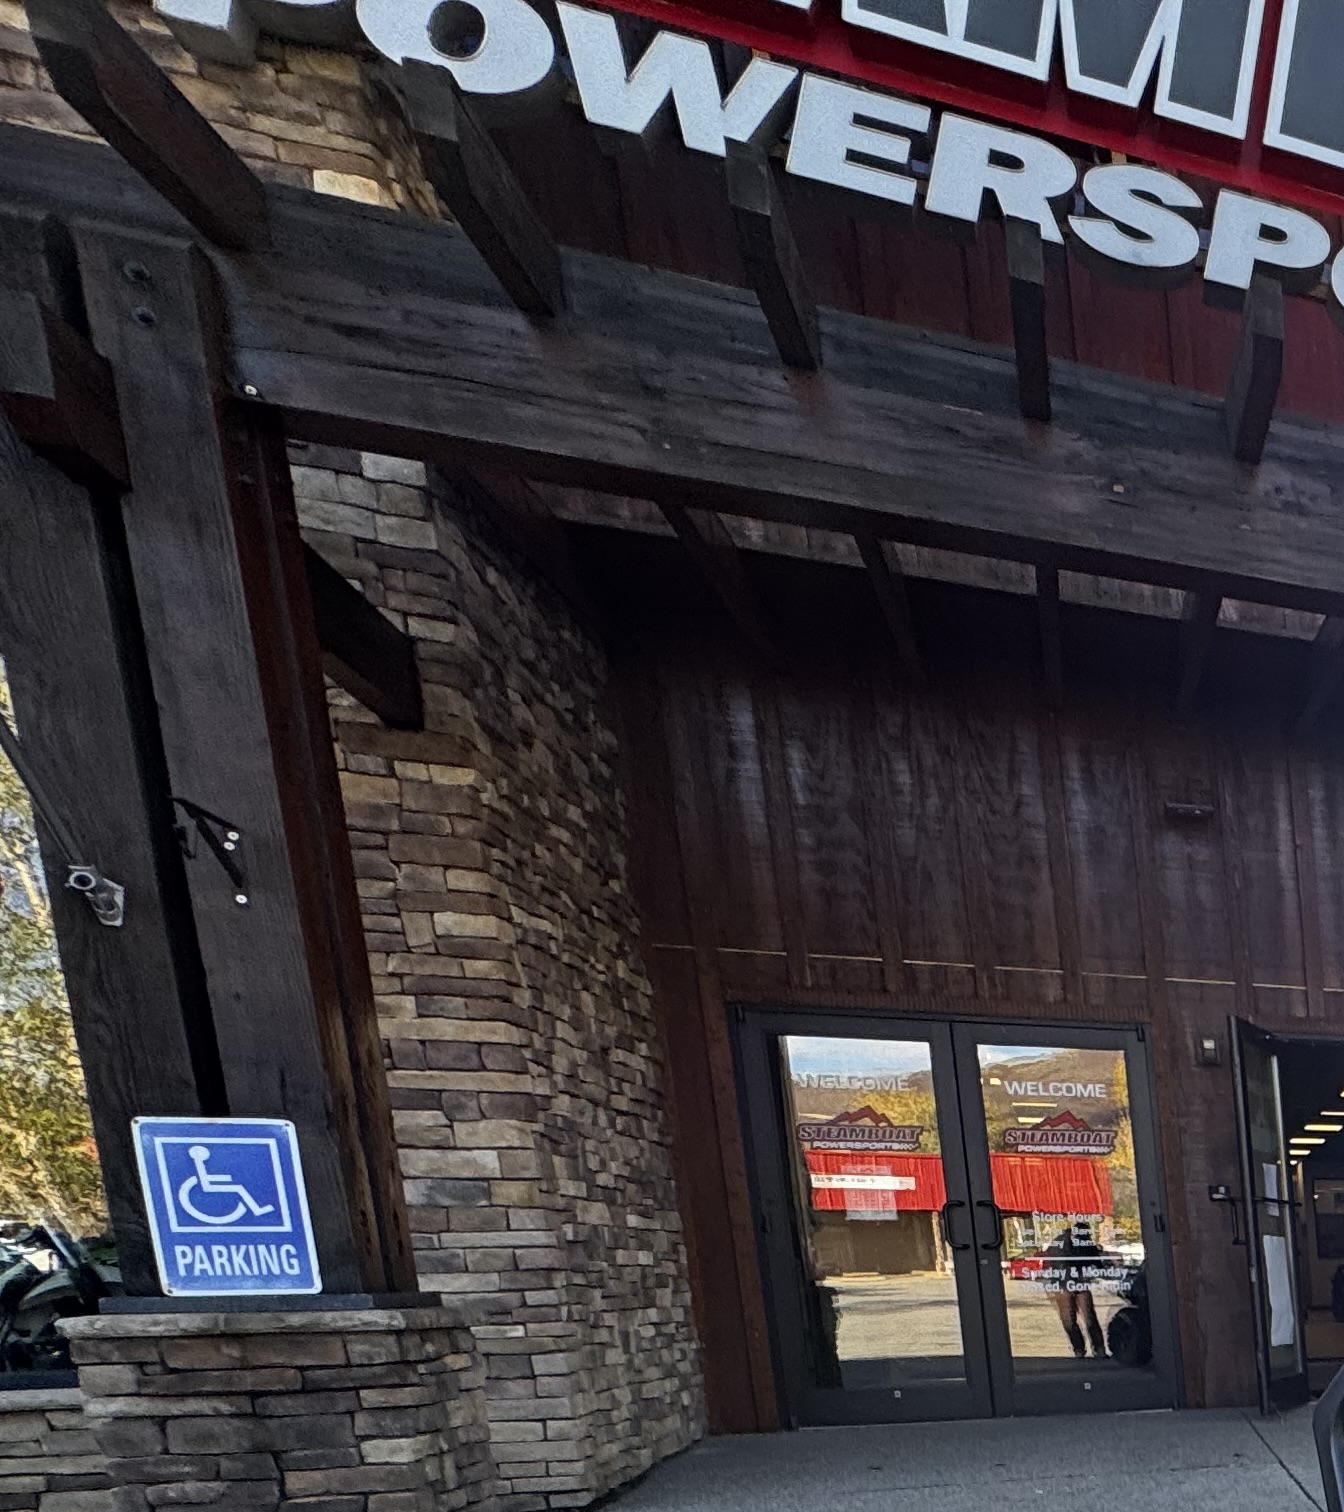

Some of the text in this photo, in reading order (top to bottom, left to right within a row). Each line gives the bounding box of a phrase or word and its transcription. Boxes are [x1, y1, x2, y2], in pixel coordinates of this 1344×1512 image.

[794, 1073, 914, 1092] WELCOME
[1004, 1080, 1108, 1098] WELCOME
[799, 1125, 922, 1141] STEAMBOAT
[1004, 1130, 1116, 1145] STEAMBOAT
[813, 1141, 898, 1150] POWERSPORTS
[174, 1243, 301, 1277] PARKING
[1021, 1266, 1128, 1279] Sunday & Monday
